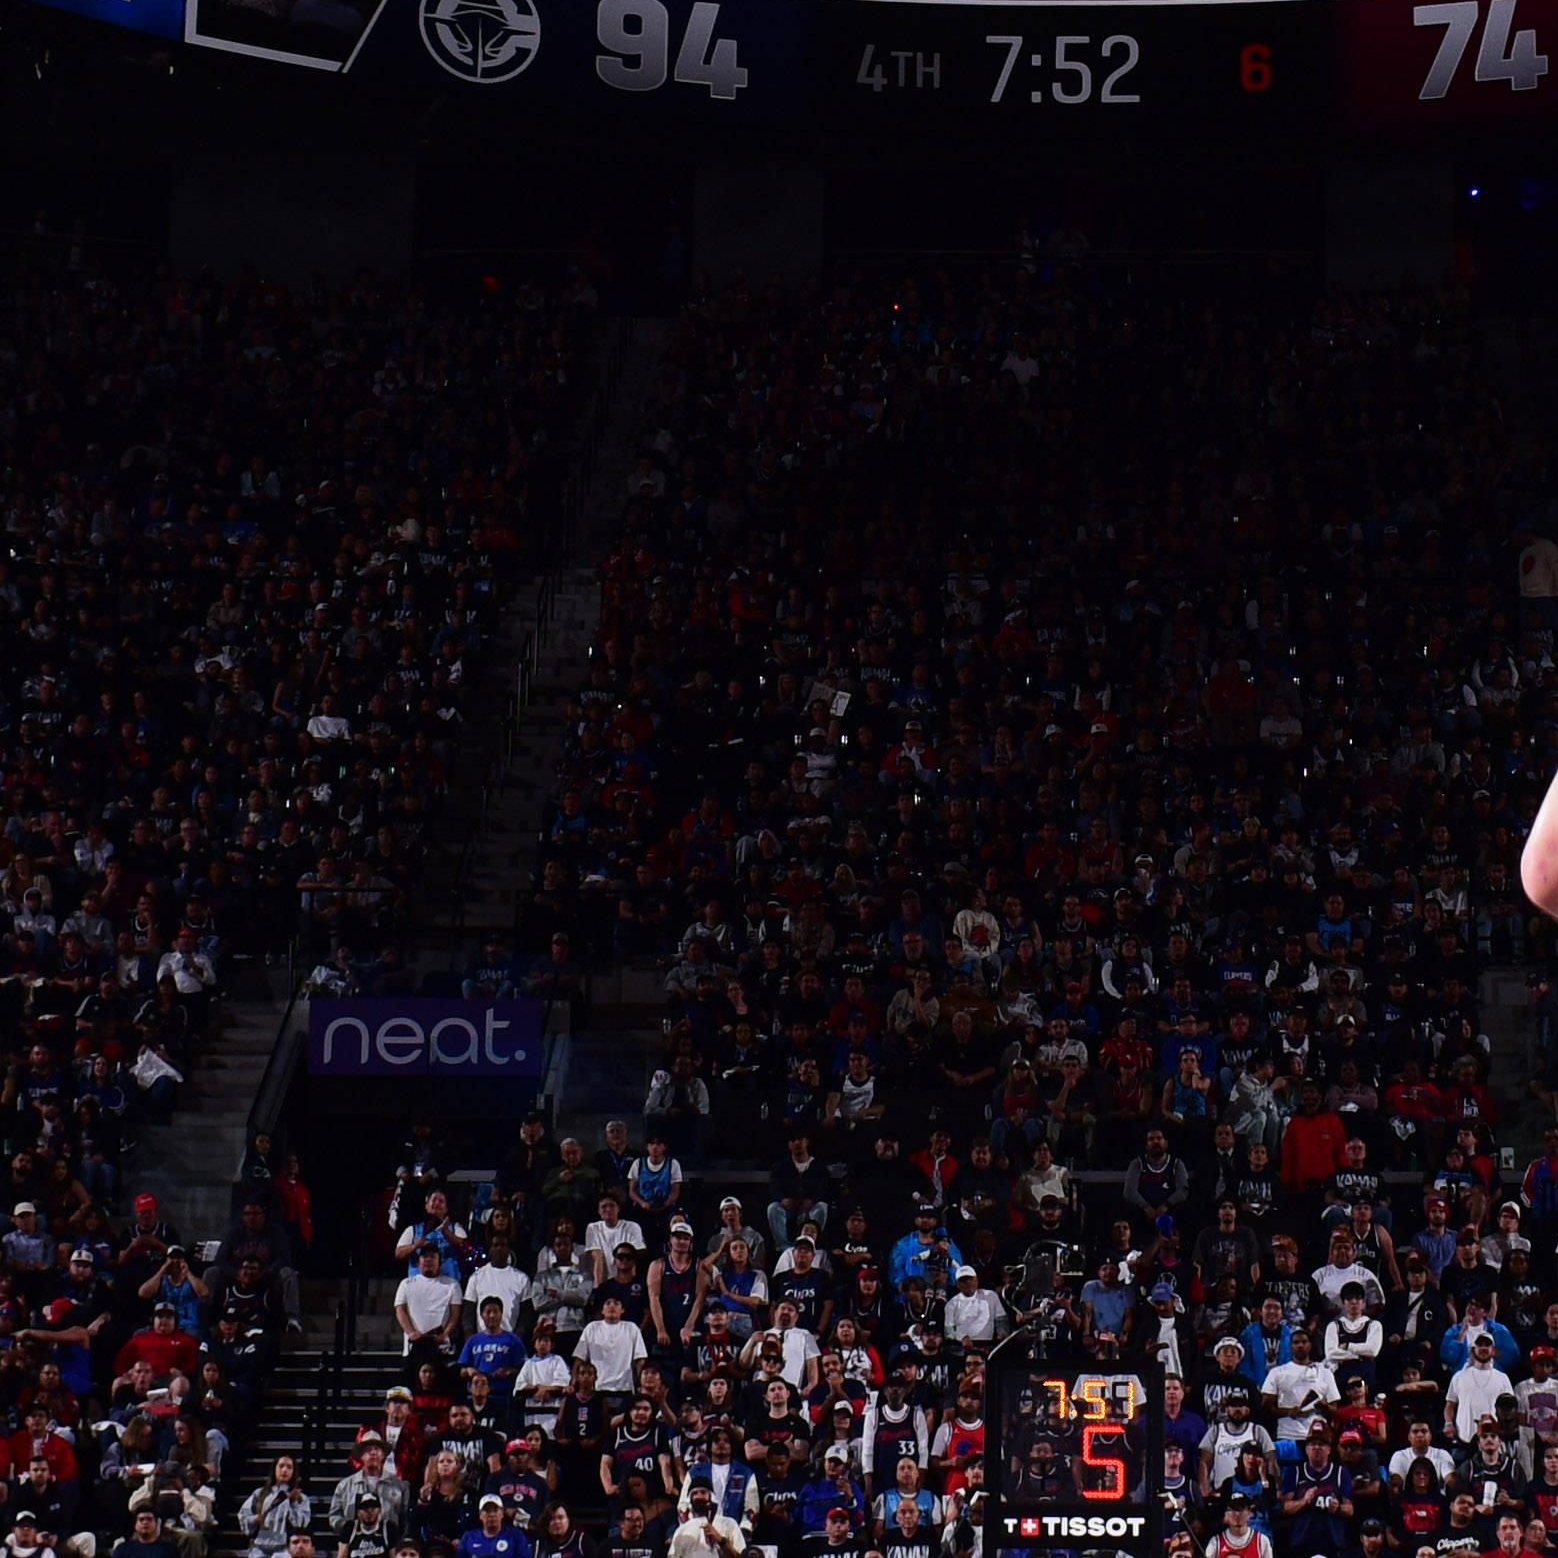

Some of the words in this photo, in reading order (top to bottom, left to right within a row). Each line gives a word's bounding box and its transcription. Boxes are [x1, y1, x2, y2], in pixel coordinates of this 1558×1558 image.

[857, 46, 942, 93] 4TH
[985, 35, 1142, 104] 7:52
[1240, 46, 1272, 92] 6
[322, 1007, 527, 1067] neat.
[635, 1456, 655, 1473] 40
[897, 1440, 916, 1456] 33
[1082, 1424, 1126, 1500] 5
[1042, 1516, 1146, 1537] TISSOT
